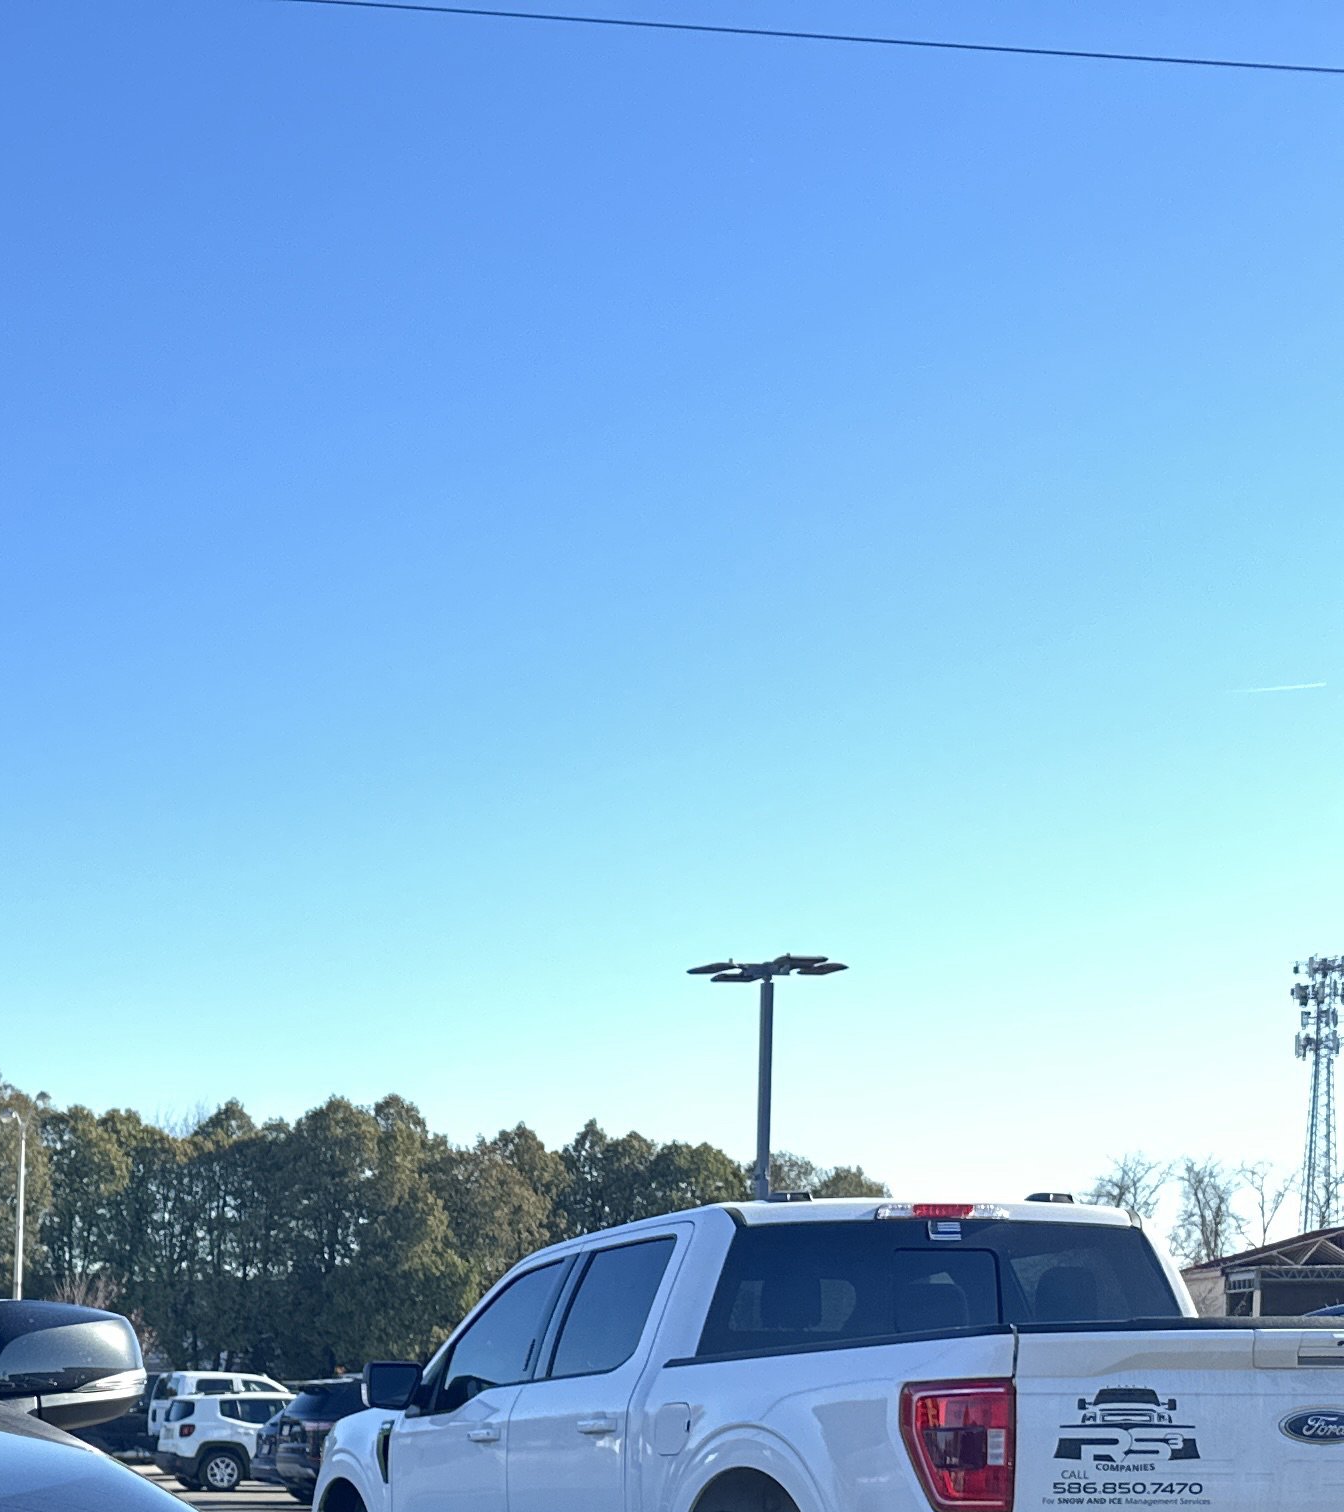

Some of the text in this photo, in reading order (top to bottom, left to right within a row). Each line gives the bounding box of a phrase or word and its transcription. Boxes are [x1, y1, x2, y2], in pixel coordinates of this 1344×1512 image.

[1095, 1463, 1156, 1472] COMPANIES
[1061, 1470, 1089, 1480] CALL
[1052, 1482, 1203, 1495] 586.850.7470
[1125, 1498, 1178, 1506] Management
